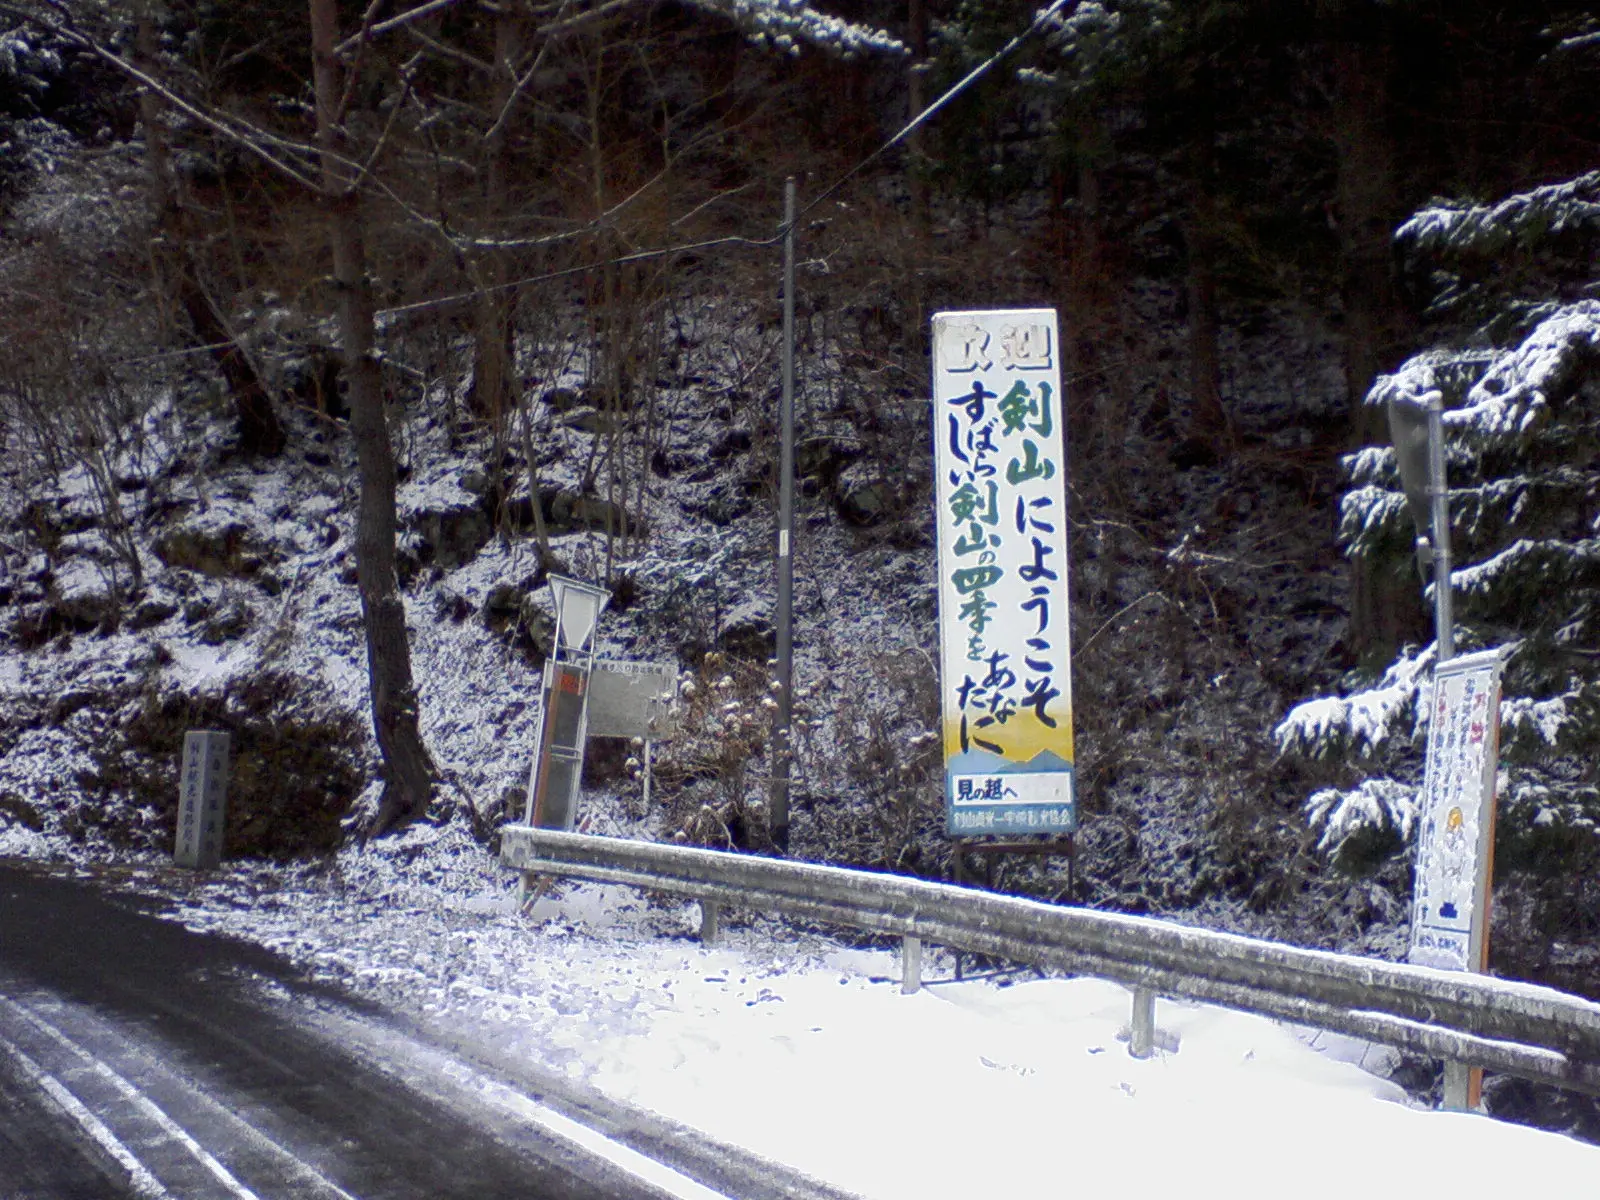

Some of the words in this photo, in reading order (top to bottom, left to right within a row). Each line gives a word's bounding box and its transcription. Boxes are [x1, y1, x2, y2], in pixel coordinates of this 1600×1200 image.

[997, 379, 1060, 728] 剣山にようこそ
